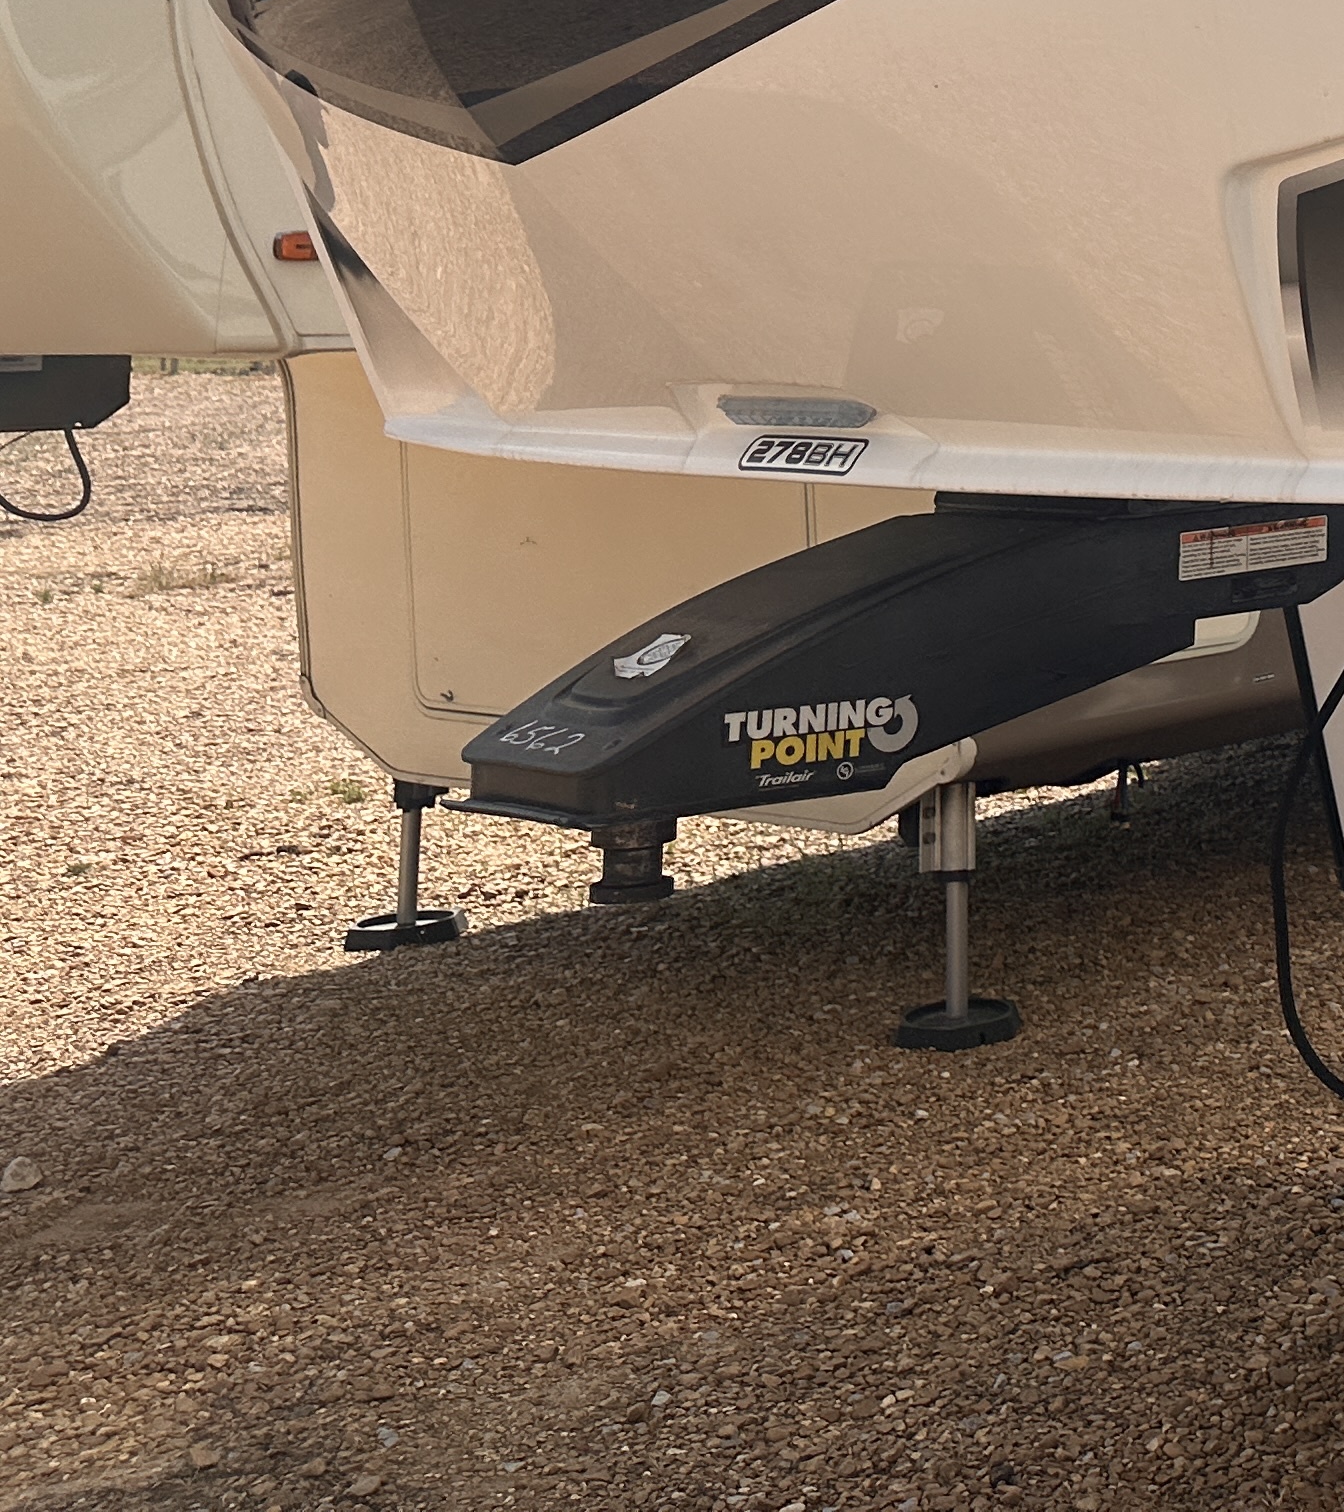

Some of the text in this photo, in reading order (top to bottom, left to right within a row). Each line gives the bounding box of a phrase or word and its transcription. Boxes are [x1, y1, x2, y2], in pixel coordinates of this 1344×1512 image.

[746, 440, 859, 468] 278BH
[724, 696, 894, 742] TURNING
[751, 728, 866, 769] POINT
[756, 769, 815, 787] Trailair
